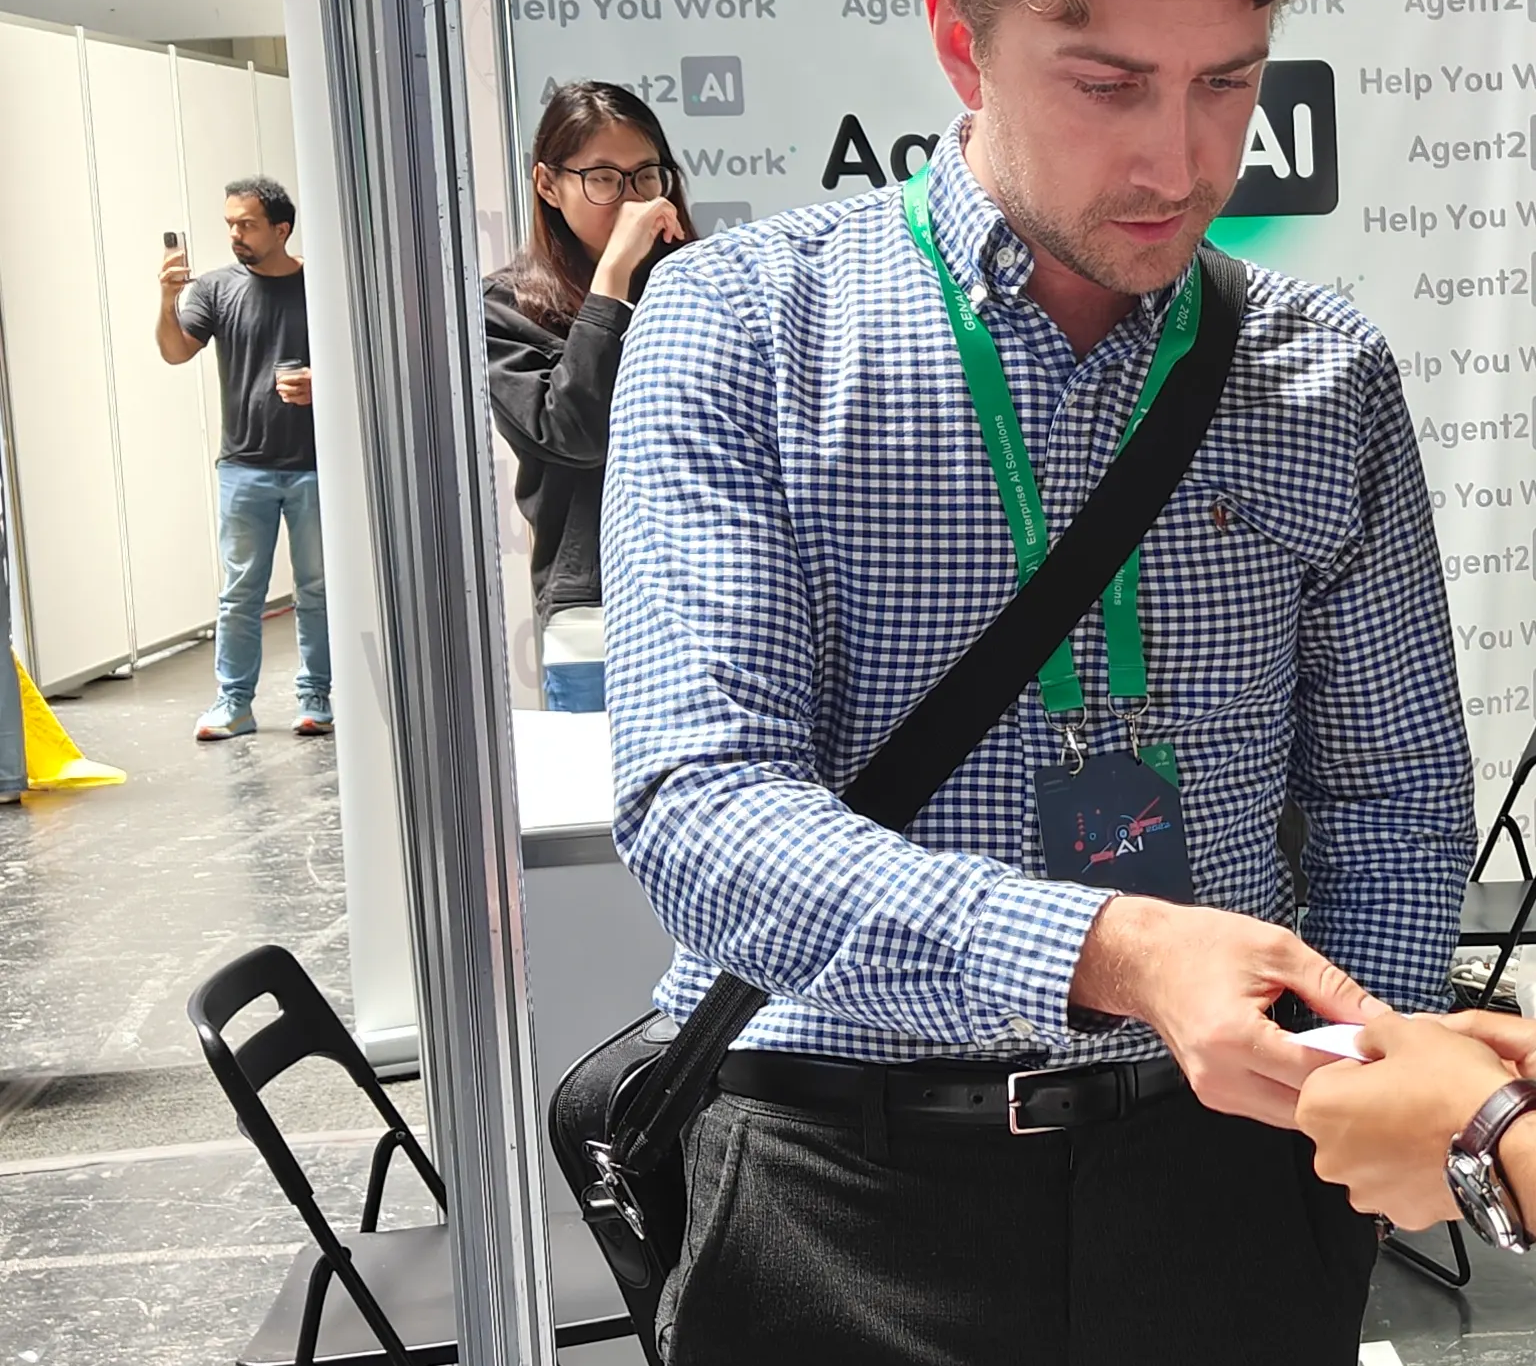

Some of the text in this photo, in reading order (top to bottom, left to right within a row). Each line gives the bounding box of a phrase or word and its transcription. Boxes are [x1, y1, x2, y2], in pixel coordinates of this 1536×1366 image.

[1359, 67, 1434, 101] Help
[1441, 66, 1503, 94] You
[682, 147, 787, 177] Work
[1408, 131, 1527, 169] Agent2
[1363, 205, 1438, 239] Help
[1446, 204, 1507, 230] You
[1413, 268, 1529, 305] Agent2
[1175, 304, 1189, 332] 2024
[1451, 348, 1511, 375] You
[994, 414, 1017, 470] Solutions
[1418, 414, 1530, 451] Agent2
[1008, 470, 1021, 484] AI
[1455, 481, 1513, 509] You
[1015, 484, 1037, 547] Enterprise
[1456, 623, 1513, 652] You
[1116, 835, 1144, 857] AI
